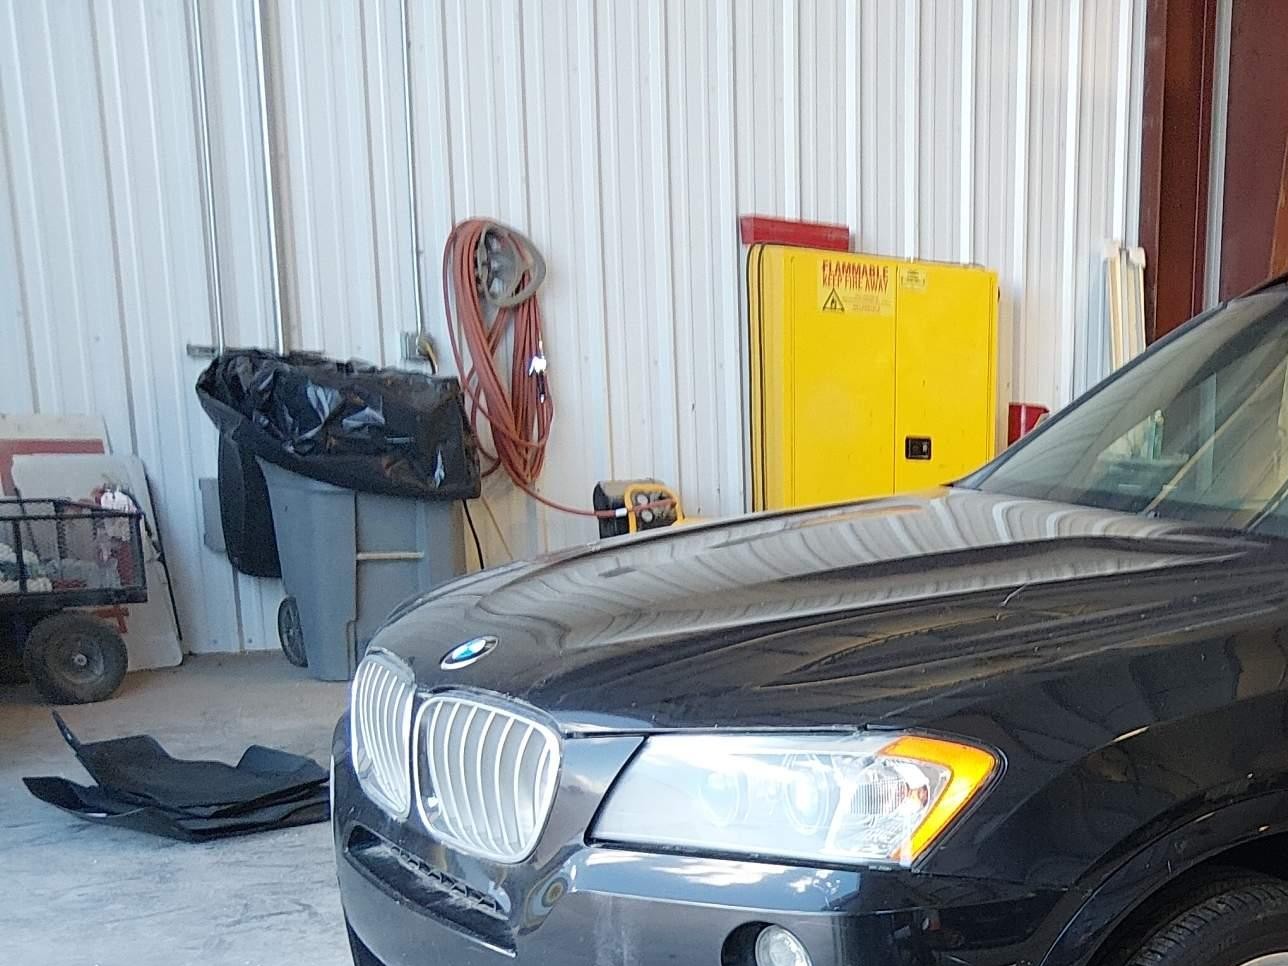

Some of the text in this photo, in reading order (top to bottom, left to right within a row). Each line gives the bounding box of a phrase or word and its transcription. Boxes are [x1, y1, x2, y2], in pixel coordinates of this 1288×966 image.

[822, 259, 889, 280] FLAMMABLE
[823, 274, 889, 294] KEEP FIRE AWAY
